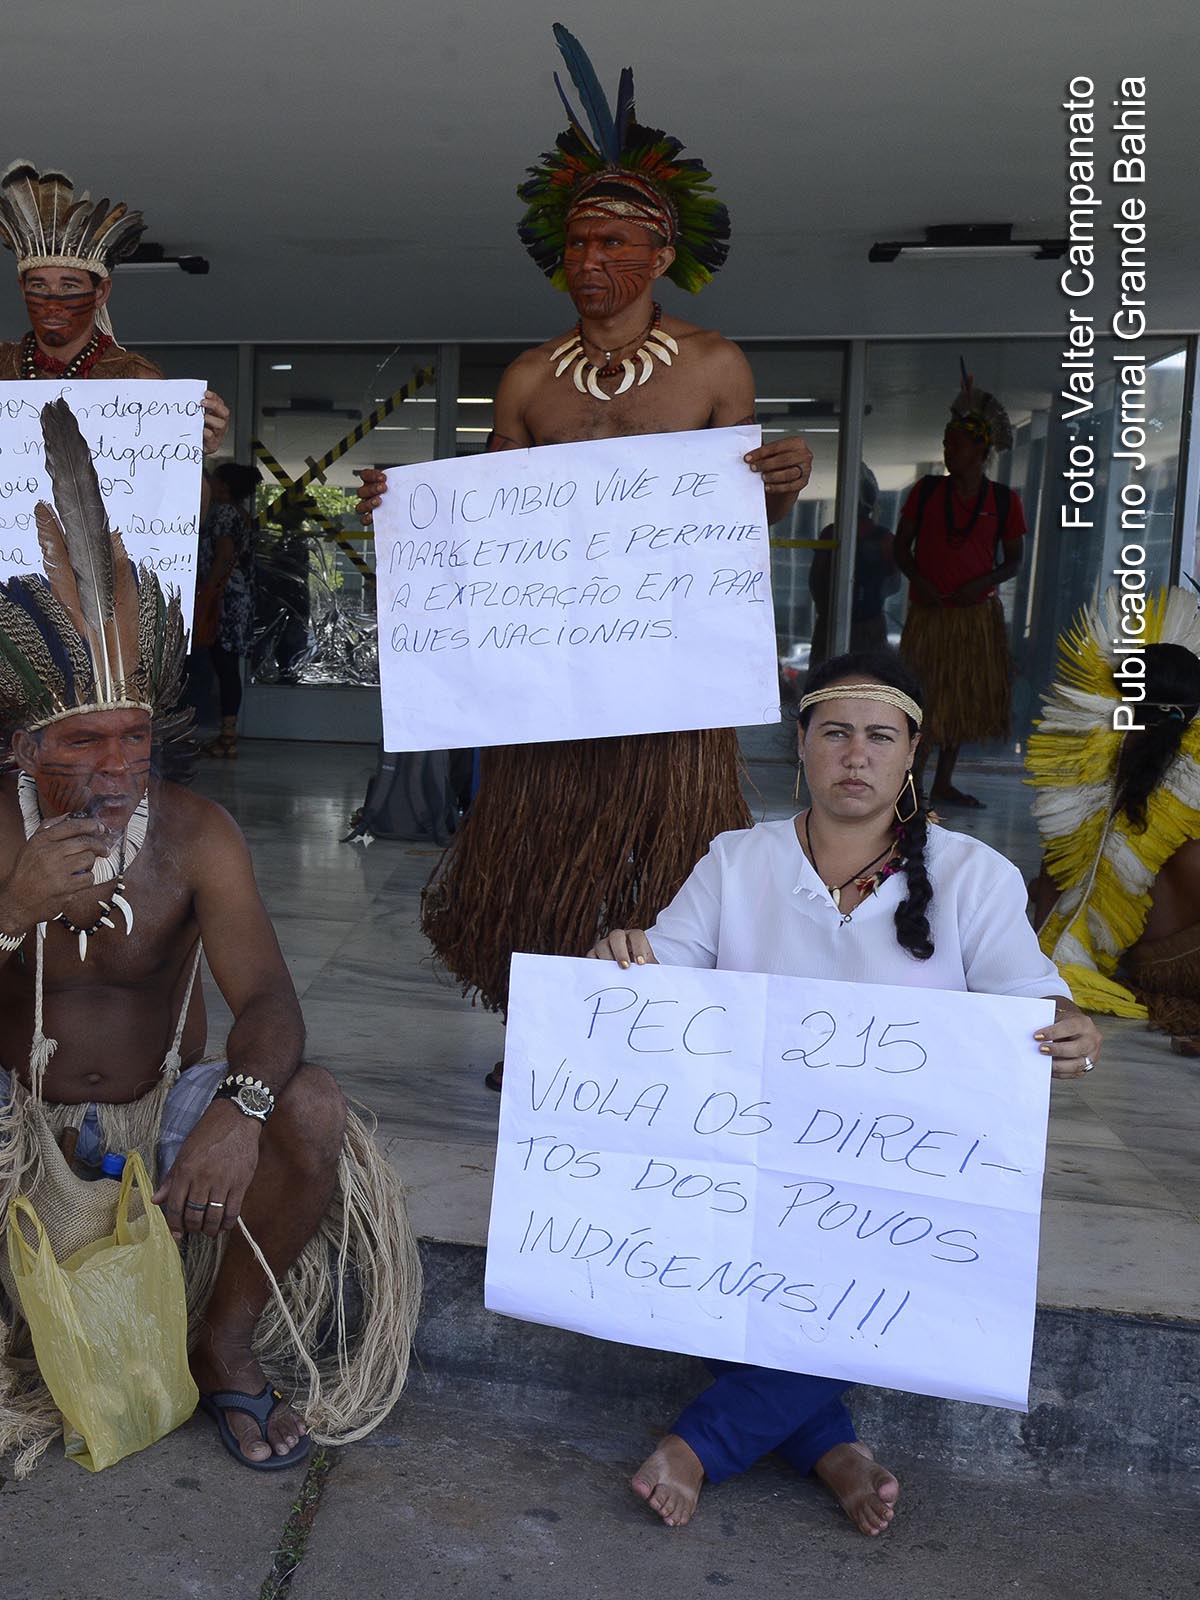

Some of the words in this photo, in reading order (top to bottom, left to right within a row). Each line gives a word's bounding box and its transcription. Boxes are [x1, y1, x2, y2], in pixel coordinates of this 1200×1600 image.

[100, 476, 134, 496] os
[409, 483, 438, 530] O
[671, 472, 720, 498] DE
[126, 513, 200, 536] saúd
[585, 531, 612, 561] E
[391, 583, 411, 613] A
[424, 576, 621, 612] EXPLORAÇÃO
[636, 572, 694, 601] EM
[390, 624, 470, 653] QUES
[584, 986, 732, 1056] PEC
[781, 1010, 928, 1074] 215
[694, 1091, 773, 1136] OS
[517, 1136, 601, 1179] TOS
[631, 1159, 747, 1214] DOS
[778, 1181, 981, 1264] POVOS
[519, 1211, 910, 1349] INDÍGENAS!!!
